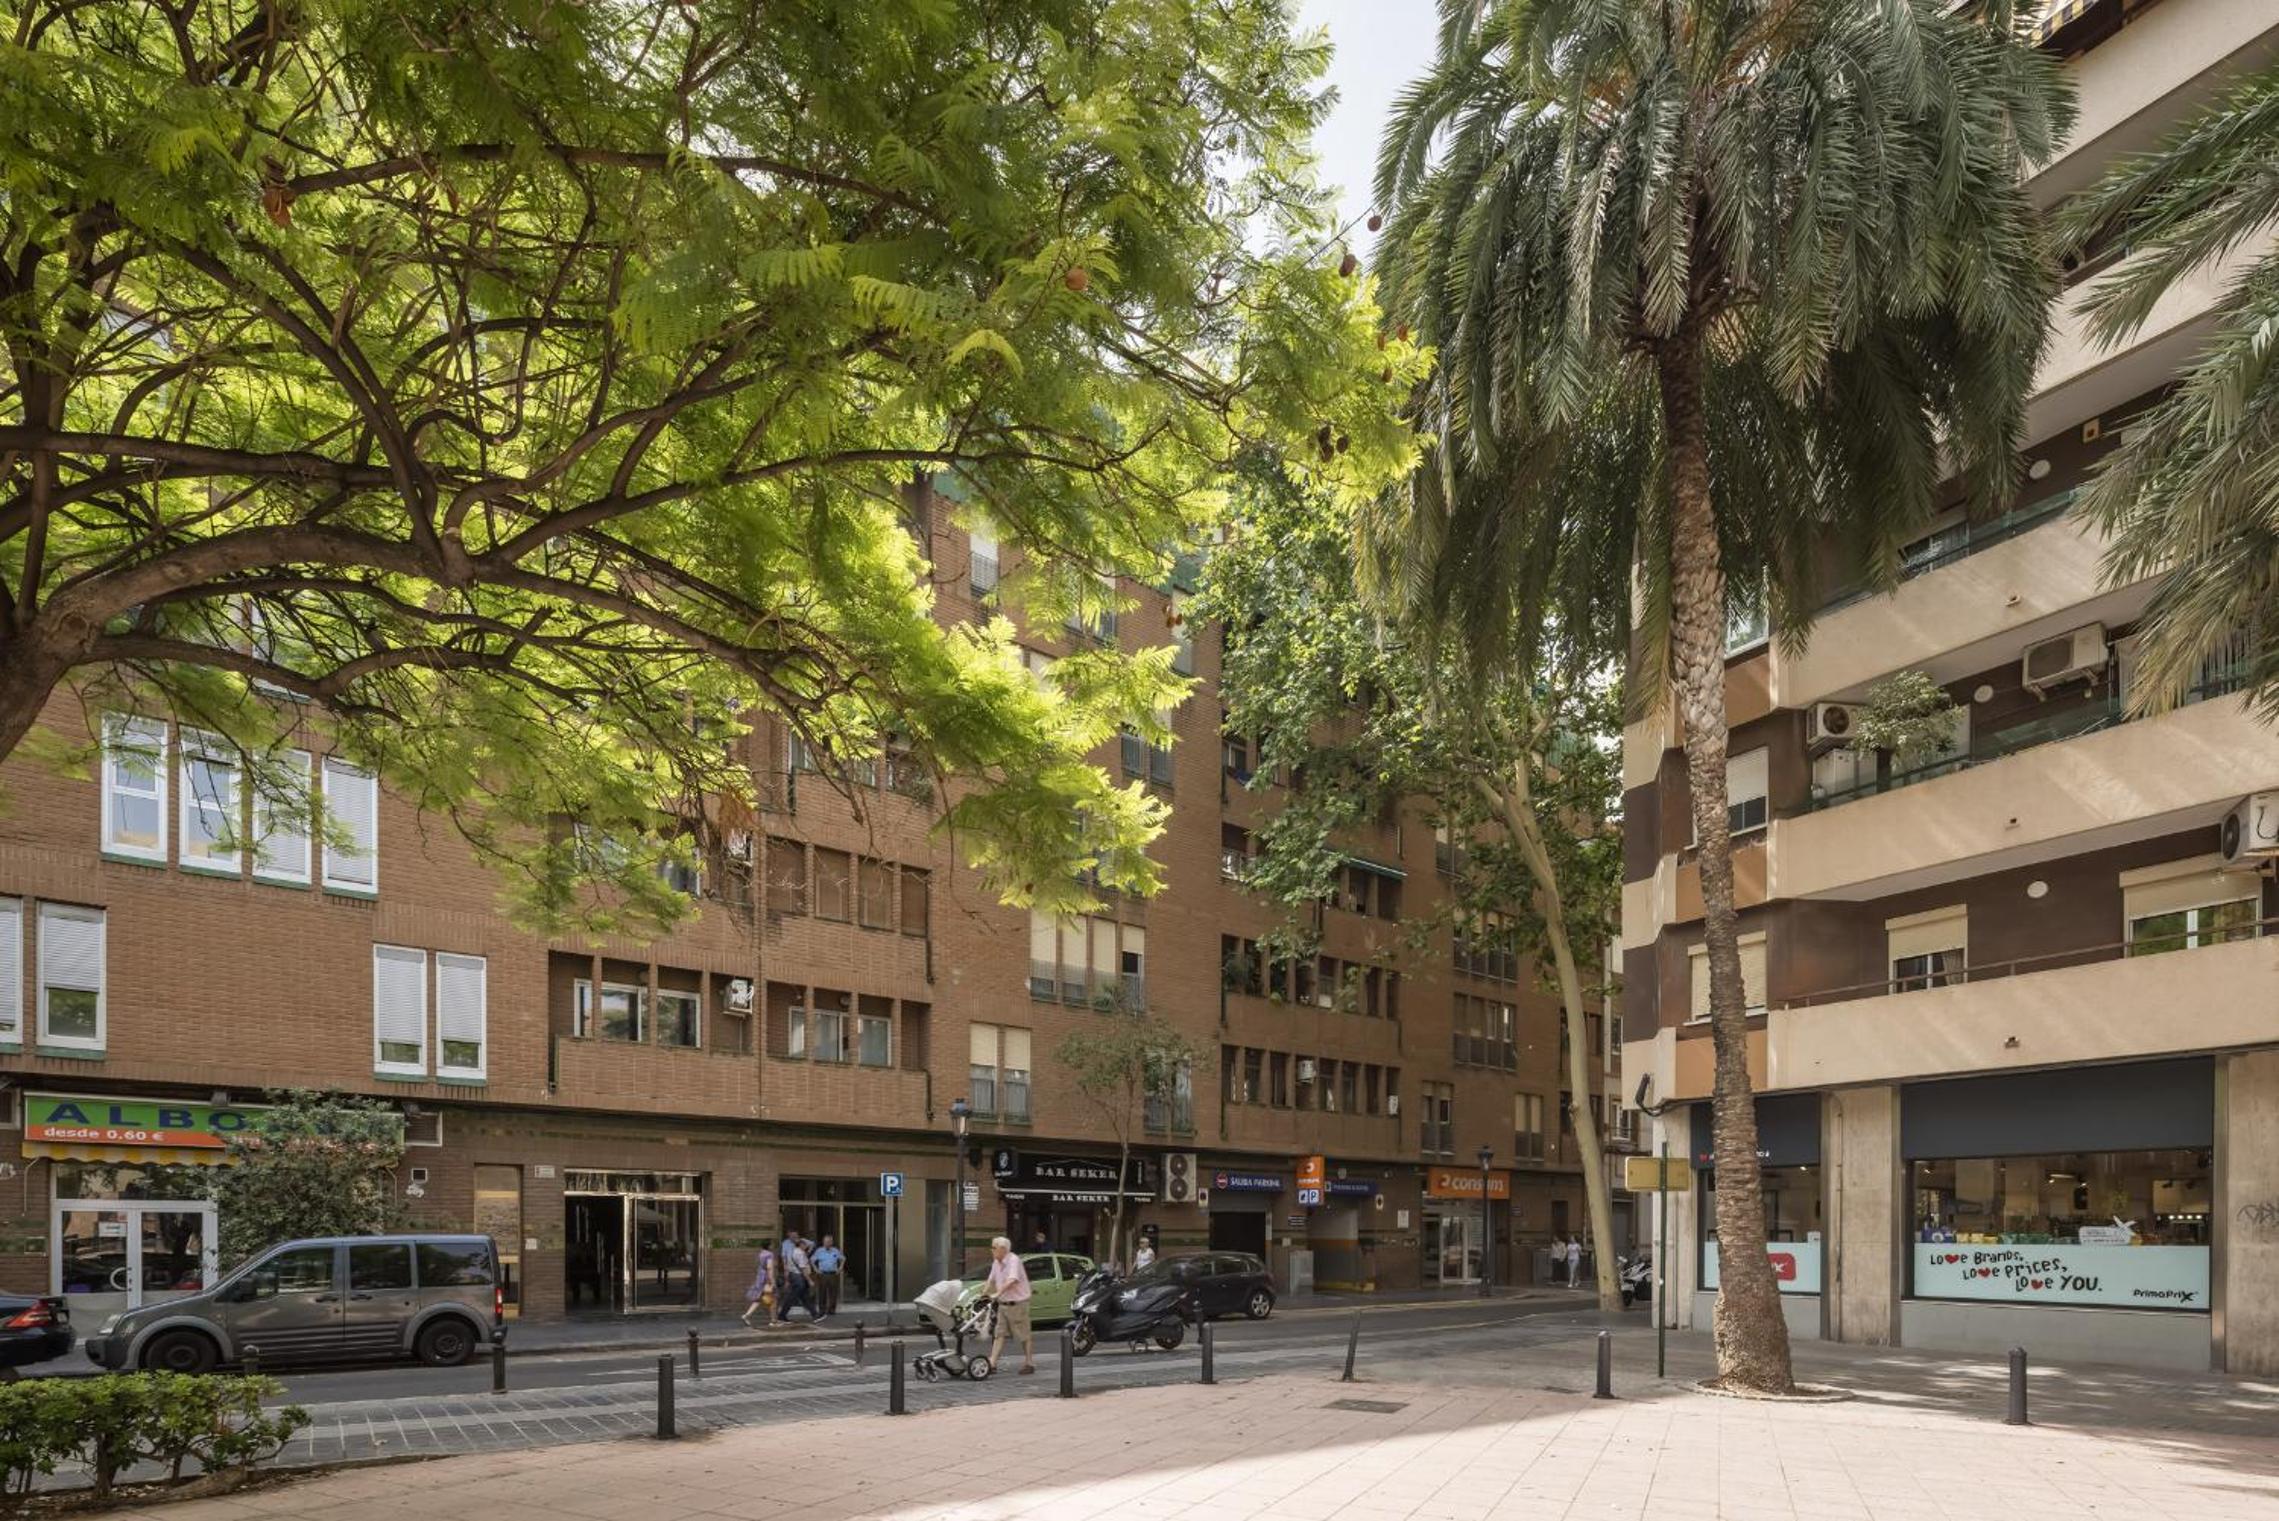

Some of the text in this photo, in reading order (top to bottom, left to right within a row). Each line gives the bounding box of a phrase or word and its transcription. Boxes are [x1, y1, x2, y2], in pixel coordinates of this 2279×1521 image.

[46, 1102, 337, 1135] ALBO
[44, 1126, 165, 1142] desde 0.60 €
[1036, 1166, 1065, 1177] BAR
[886, 1175, 899, 1192] P
[1052, 1194, 1074, 1202] BAR
[2060, 1275, 2103, 1293] YOU.
